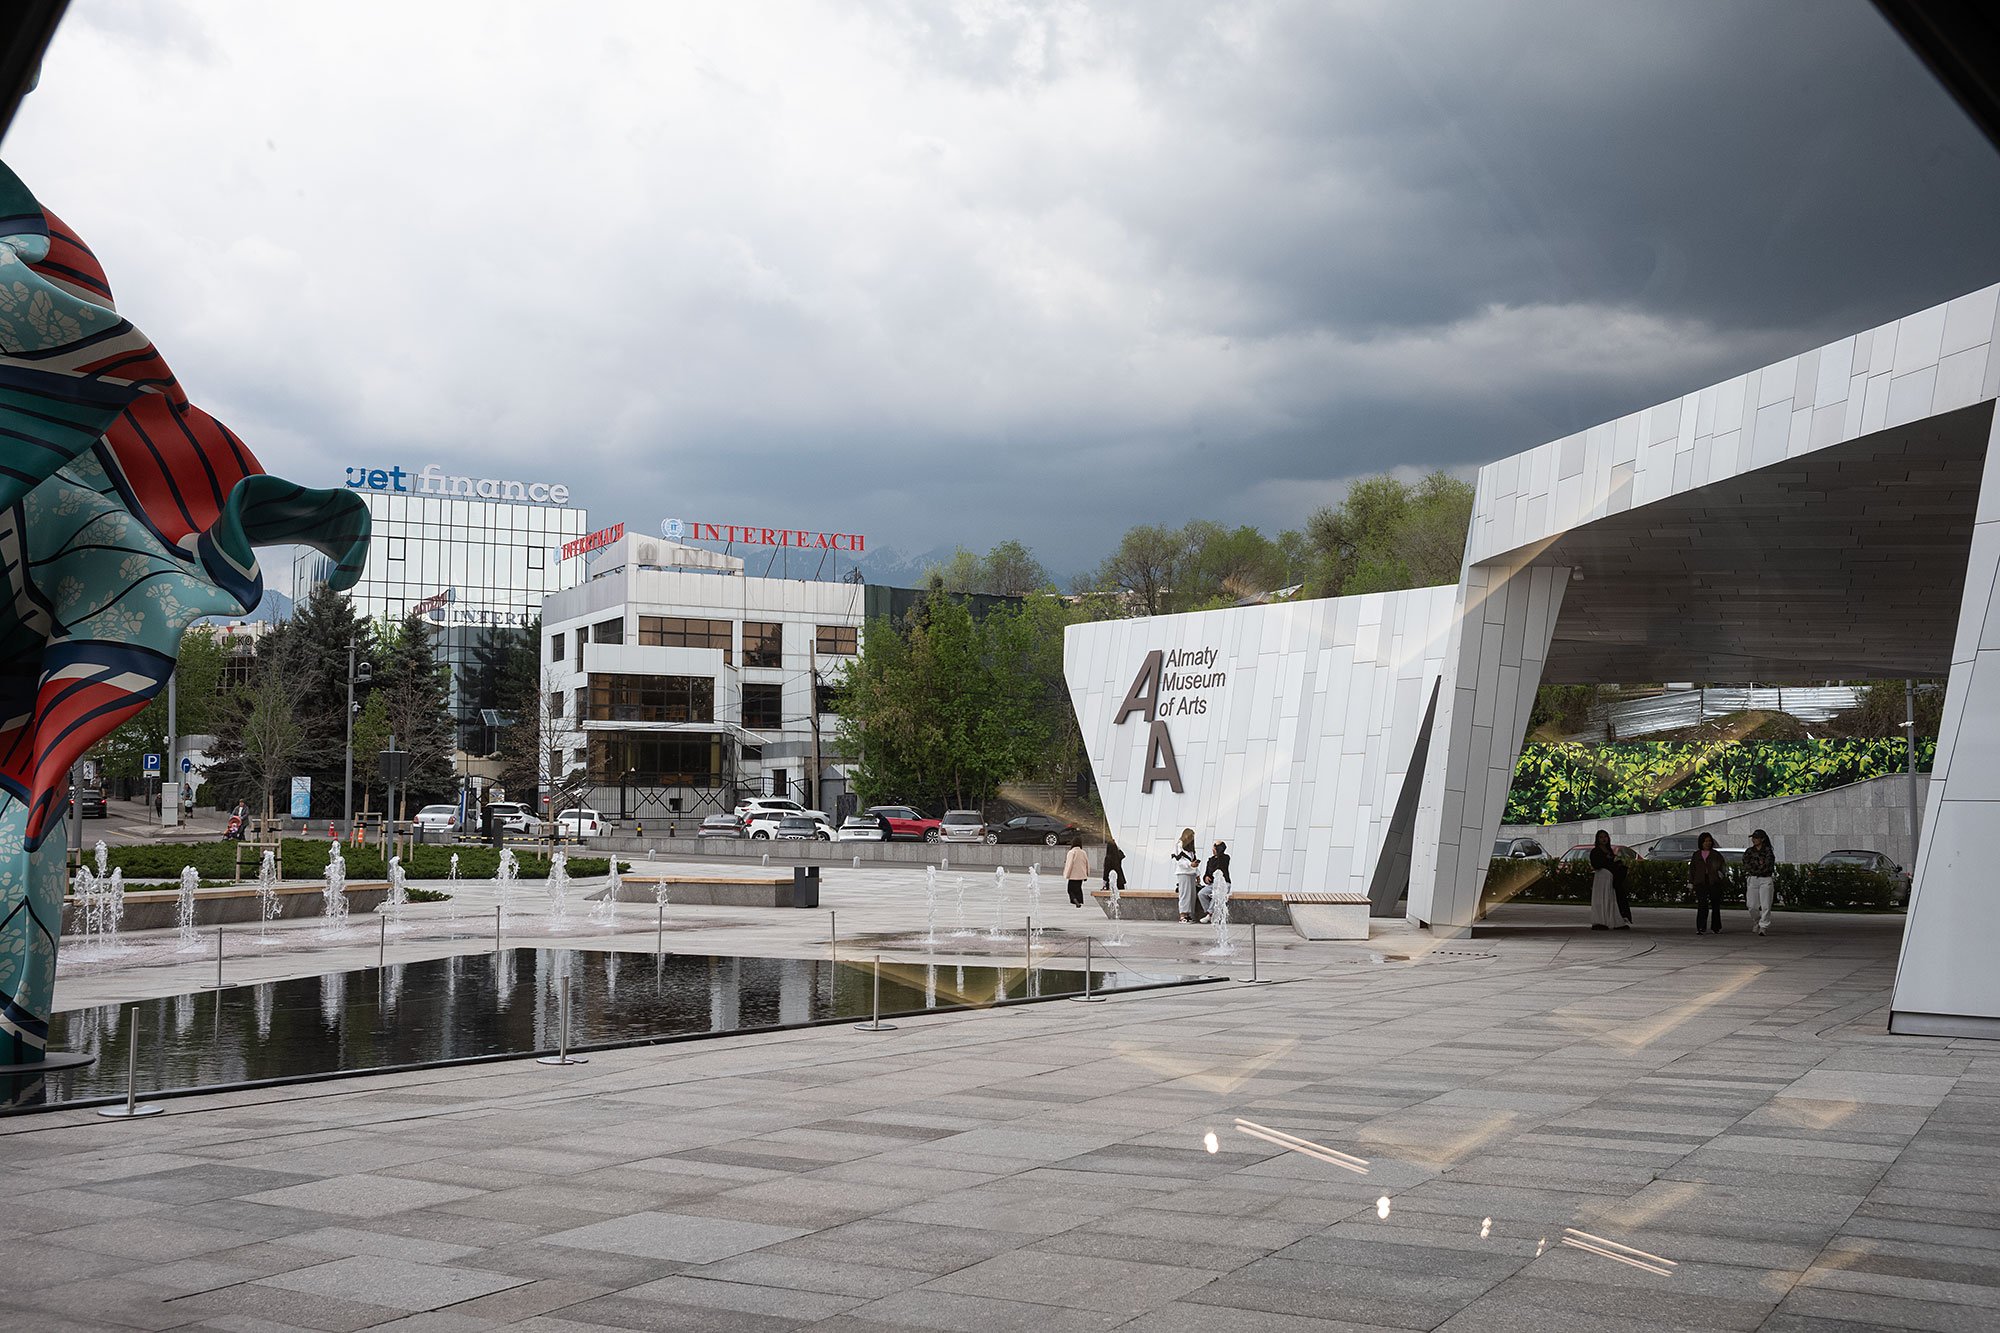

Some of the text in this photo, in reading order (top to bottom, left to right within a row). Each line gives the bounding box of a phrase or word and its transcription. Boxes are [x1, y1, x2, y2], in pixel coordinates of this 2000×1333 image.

[418, 464, 569, 503] finance
[563, 522, 625, 560] INTERTEACH
[691, 522, 865, 551] INTERTEACH
[1165, 646, 1218, 669] Almaty
[1162, 672, 1226, 692] Museum
[1159, 696, 1208, 717] of Arts
[147, 755, 158, 769] P
